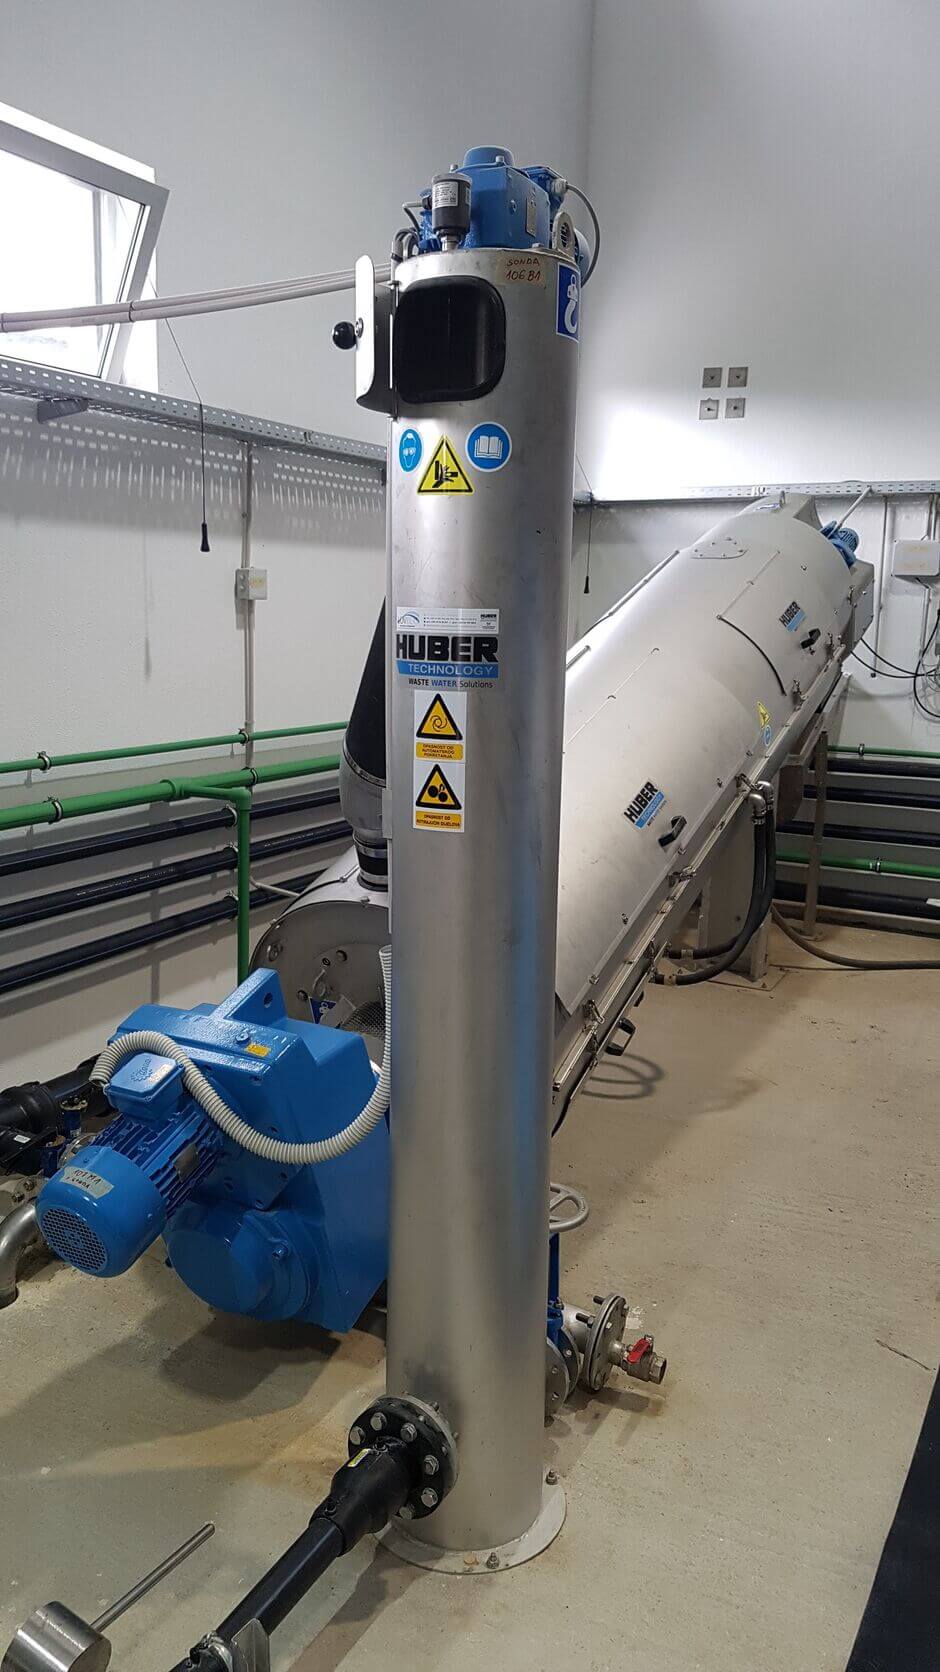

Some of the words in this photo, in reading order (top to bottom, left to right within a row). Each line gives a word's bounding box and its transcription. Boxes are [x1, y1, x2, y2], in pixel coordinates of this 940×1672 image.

[507, 258, 540, 266] SONDA
[779, 601, 800, 627] HUBER
[396, 634, 499, 662] HUBER
[408, 663, 493, 675] TECHNOLOGY
[408, 678, 430, 686] WASTE
[431, 679, 457, 688] WATER
[459, 680, 493, 689] Solutions
[623, 781, 659, 824] HUBER
